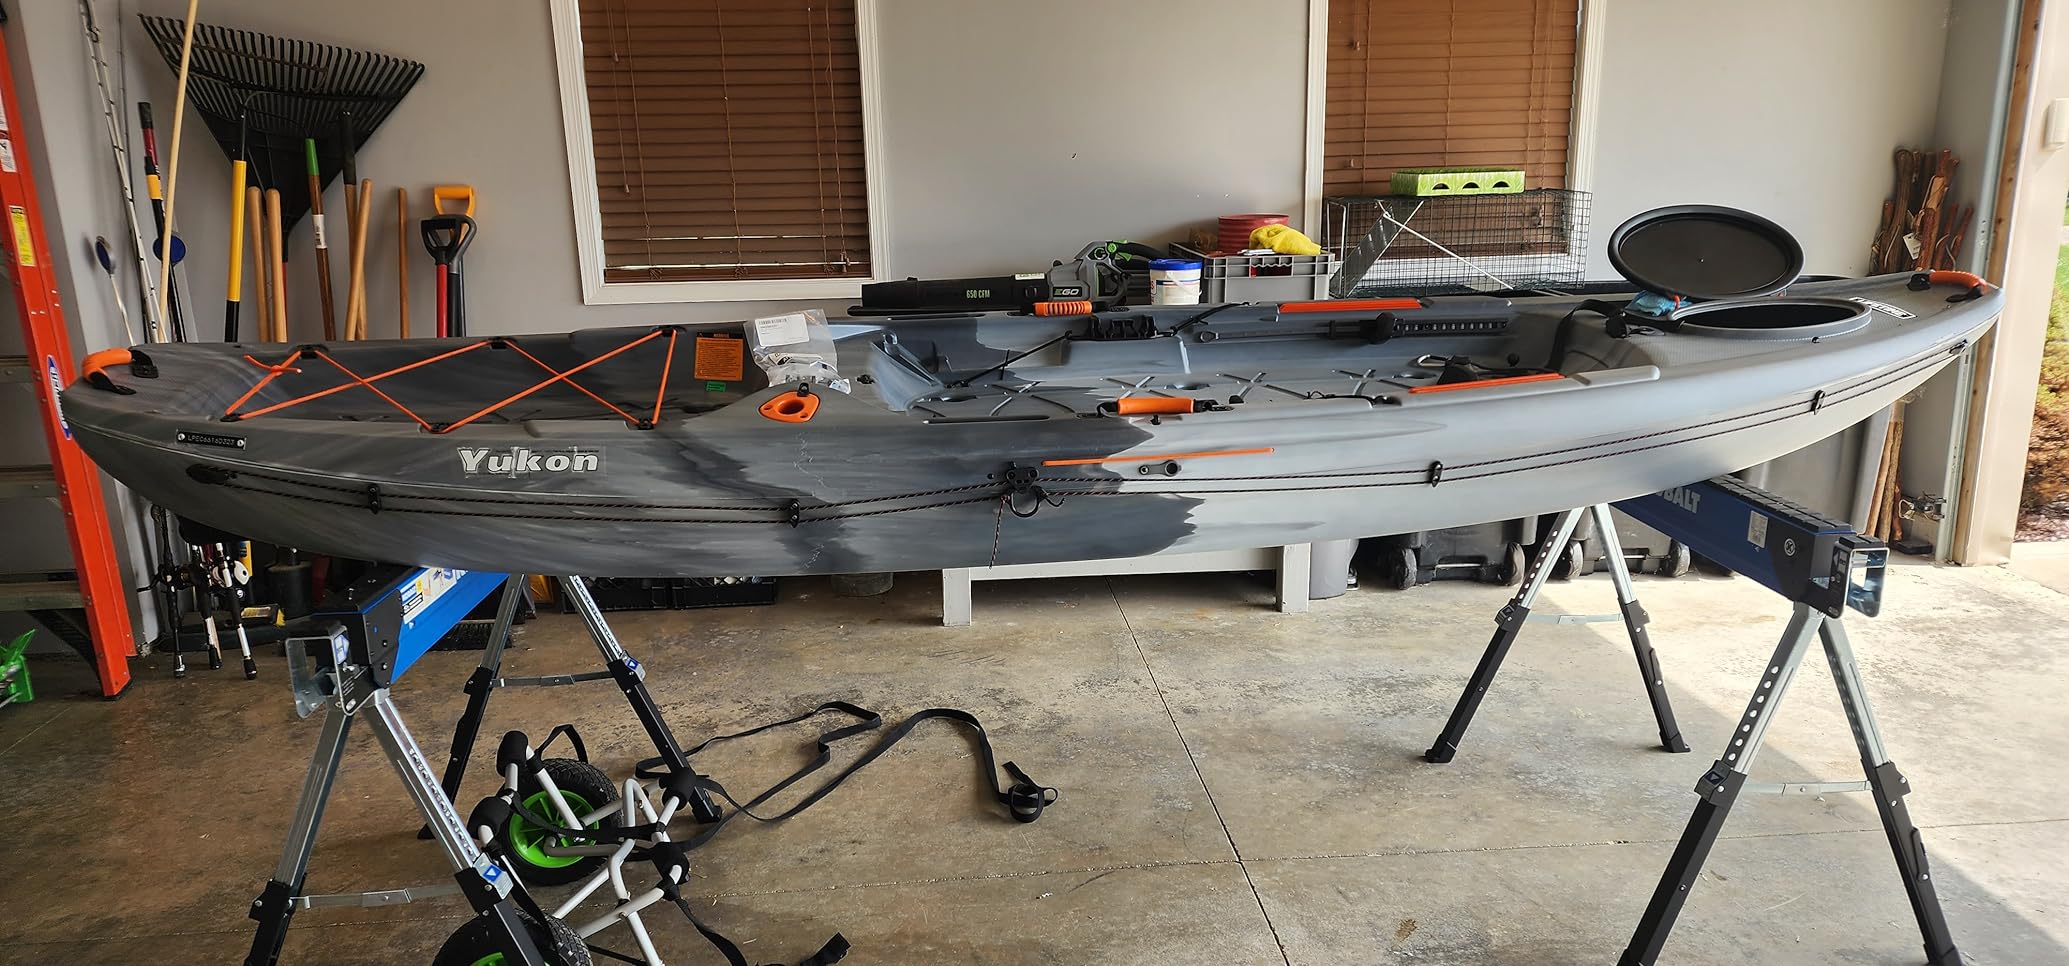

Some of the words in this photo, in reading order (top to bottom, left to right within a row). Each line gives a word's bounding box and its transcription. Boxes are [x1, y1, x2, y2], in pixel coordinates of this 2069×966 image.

[966, 289, 978, 299] 650
[978, 289, 991, 299] CFM
[1054, 288, 1080, 296] EGO
[458, 447, 599, 473] Yukon
[1657, 487, 1701, 514] BALT
